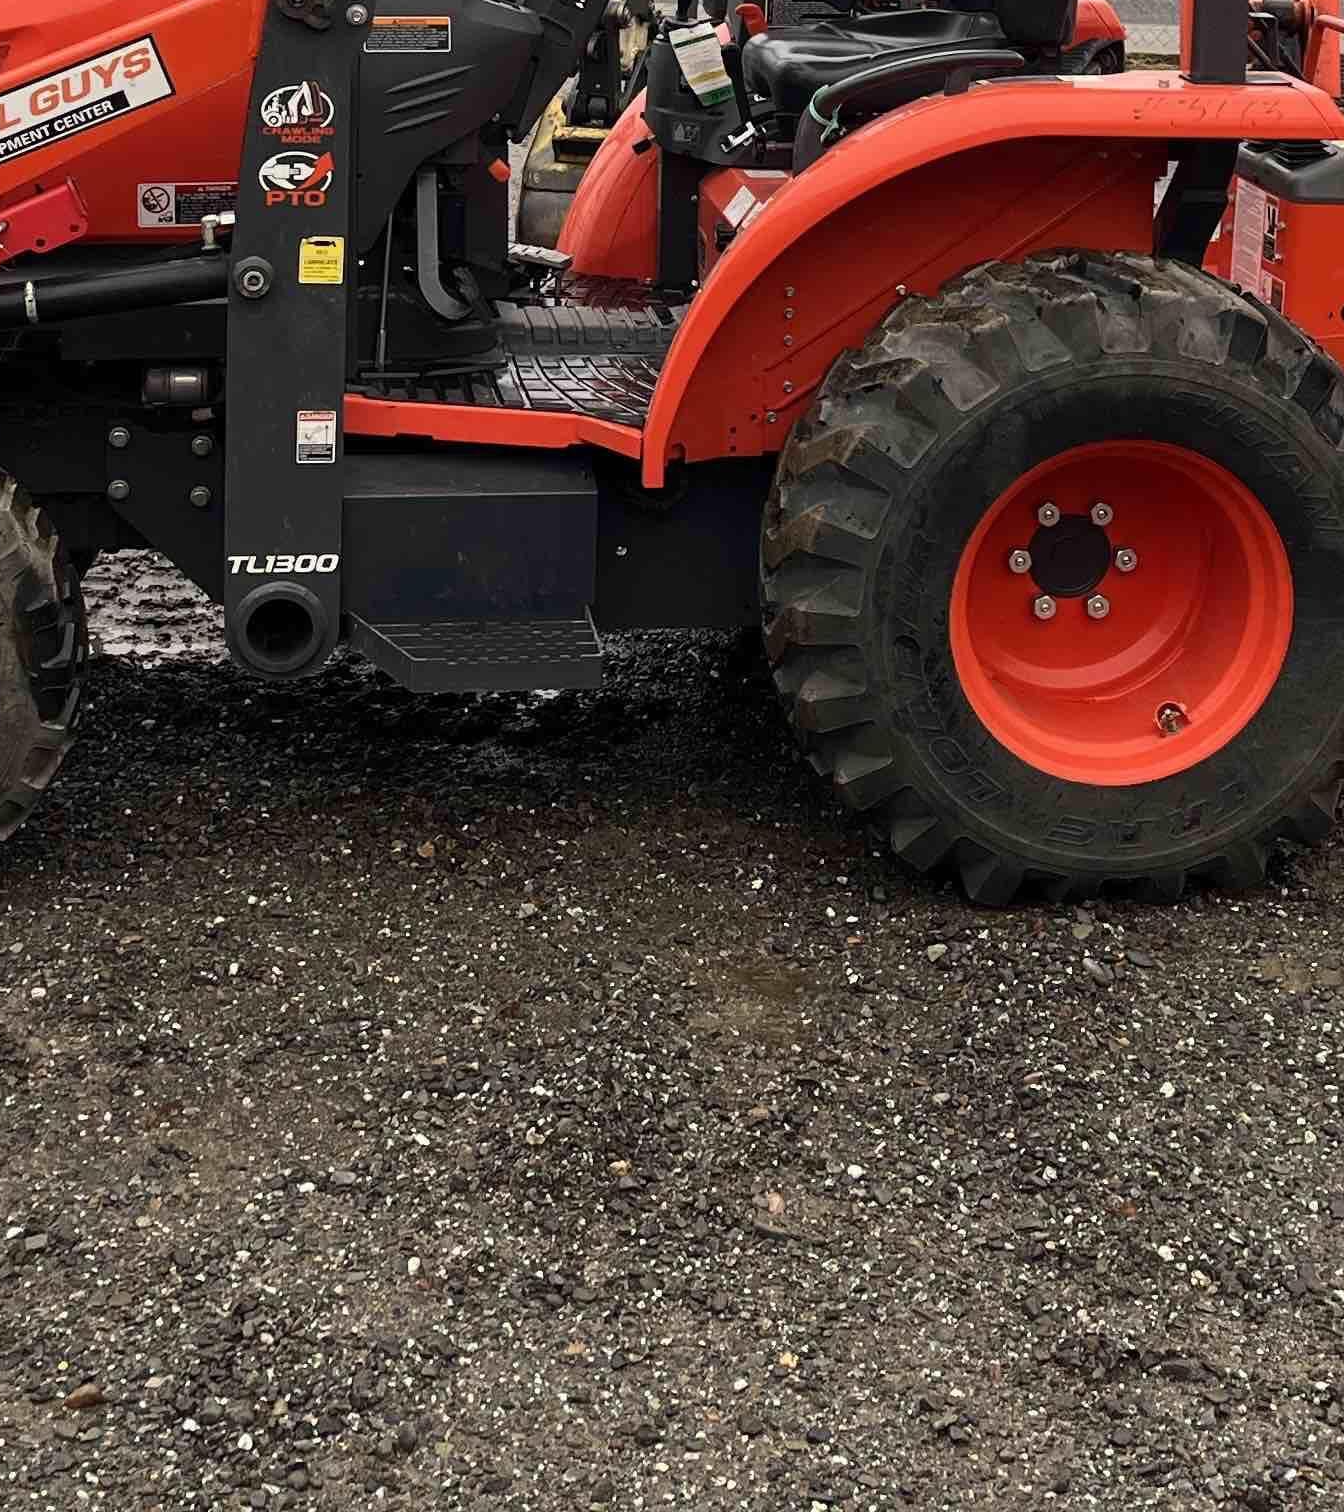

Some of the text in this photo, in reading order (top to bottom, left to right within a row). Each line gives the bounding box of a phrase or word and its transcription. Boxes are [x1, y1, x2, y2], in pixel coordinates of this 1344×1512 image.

[29, 47, 152, 118] GUYS
[53, 100, 115, 132] CENTER
[266, 190, 326, 206] PTO
[227, 553, 339, 575] TL1300
